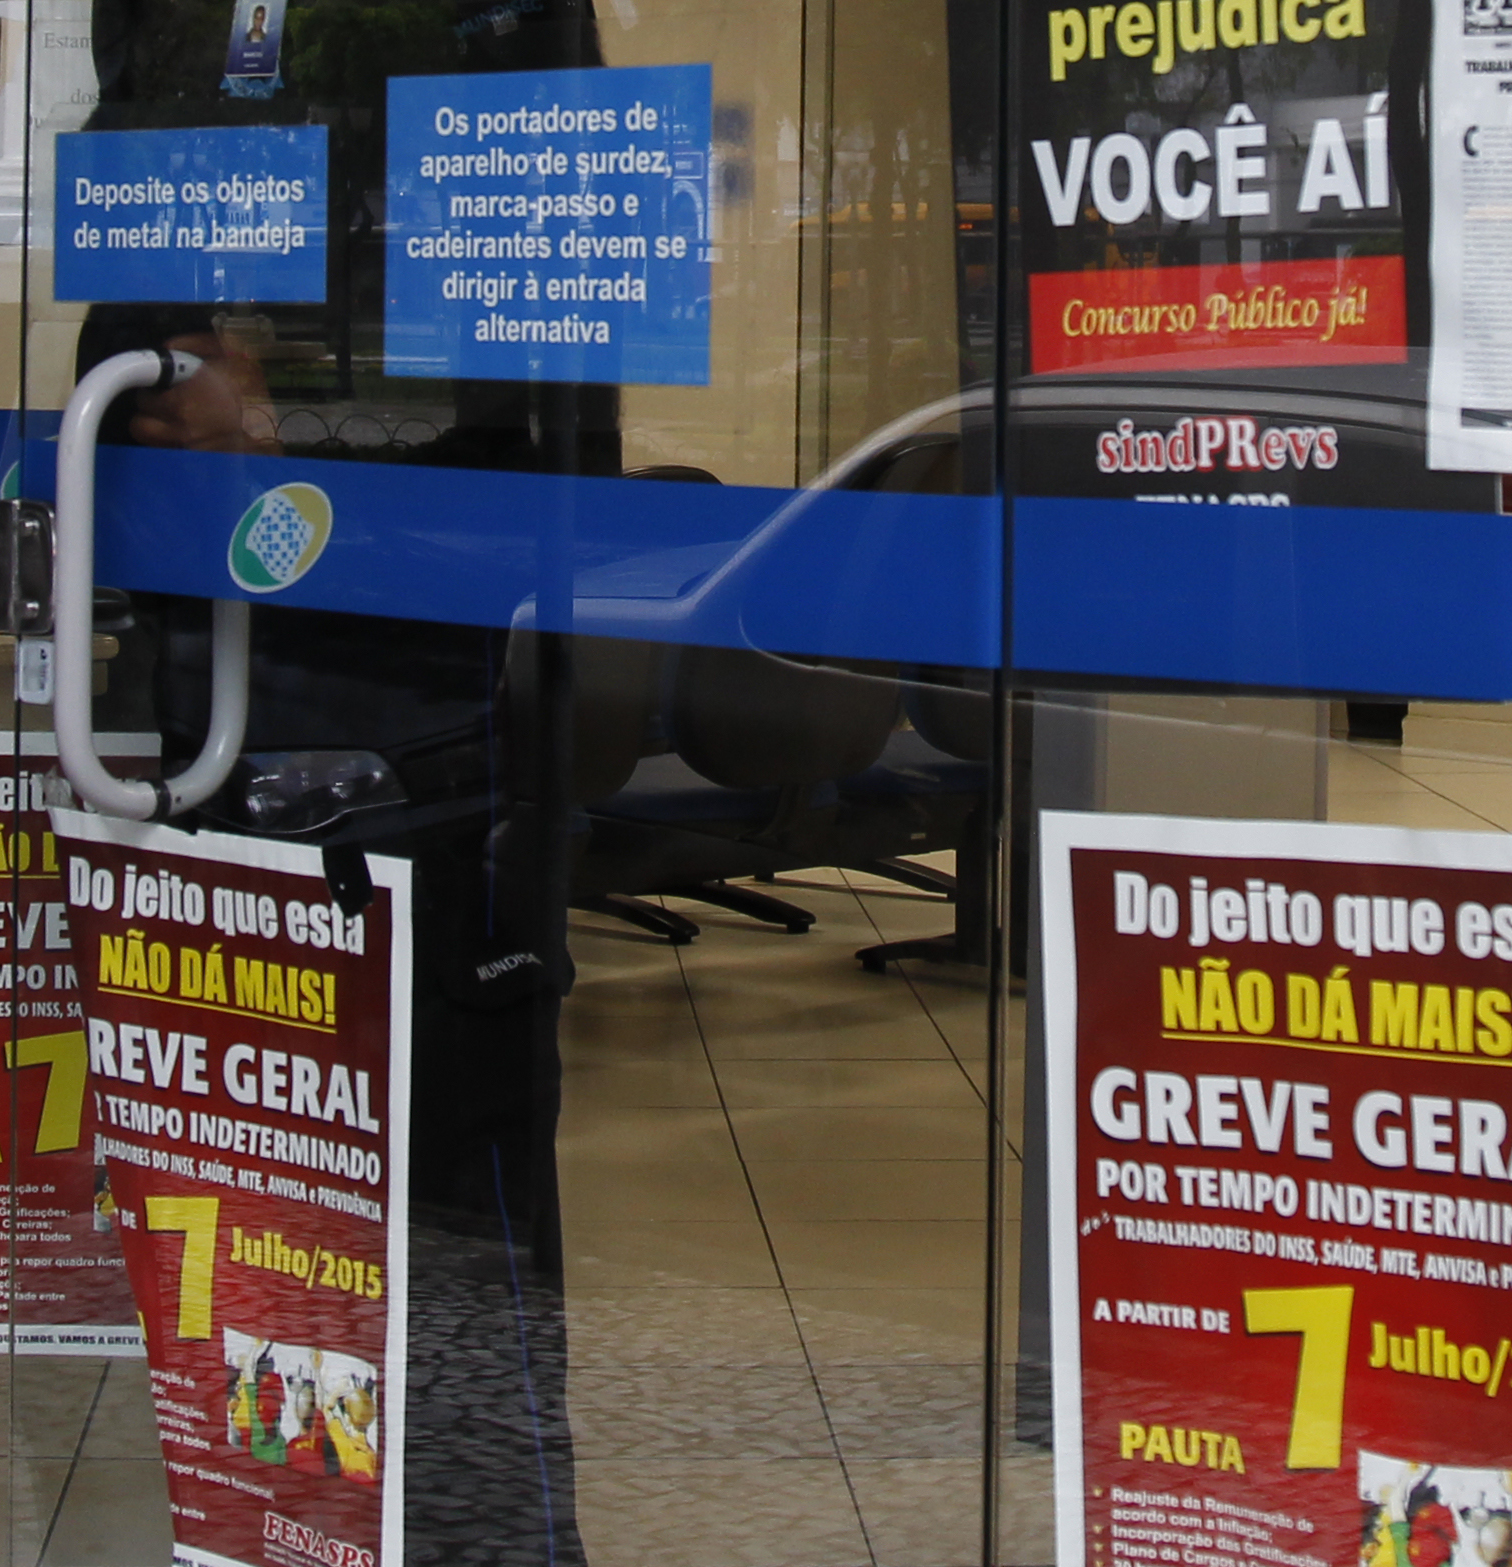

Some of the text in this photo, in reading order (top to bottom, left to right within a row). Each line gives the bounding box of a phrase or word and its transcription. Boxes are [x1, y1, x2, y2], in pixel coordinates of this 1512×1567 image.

[435, 103, 657, 140] Os portadores de
[420, 144, 673, 181] aparelho de surdez,
[1031, 93, 1391, 228] VOCÊ AÍ
[75, 174, 305, 208] Deposite os objetos
[450, 190, 639, 222] marca-passo e
[75, 222, 305, 254] de metal na bandeja
[406, 231, 686, 260] cadeirantes devem se
[443, 272, 645, 305] dirigir à entrada
[1062, 285, 1368, 339] Concurso Público já!
[475, 316, 609, 344] alternativa
[1098, 415, 1339, 473] sindPRevs
[1097, 1159, 1166, 1204] POR
[1177, 1165, 1298, 1216] TEMPO
